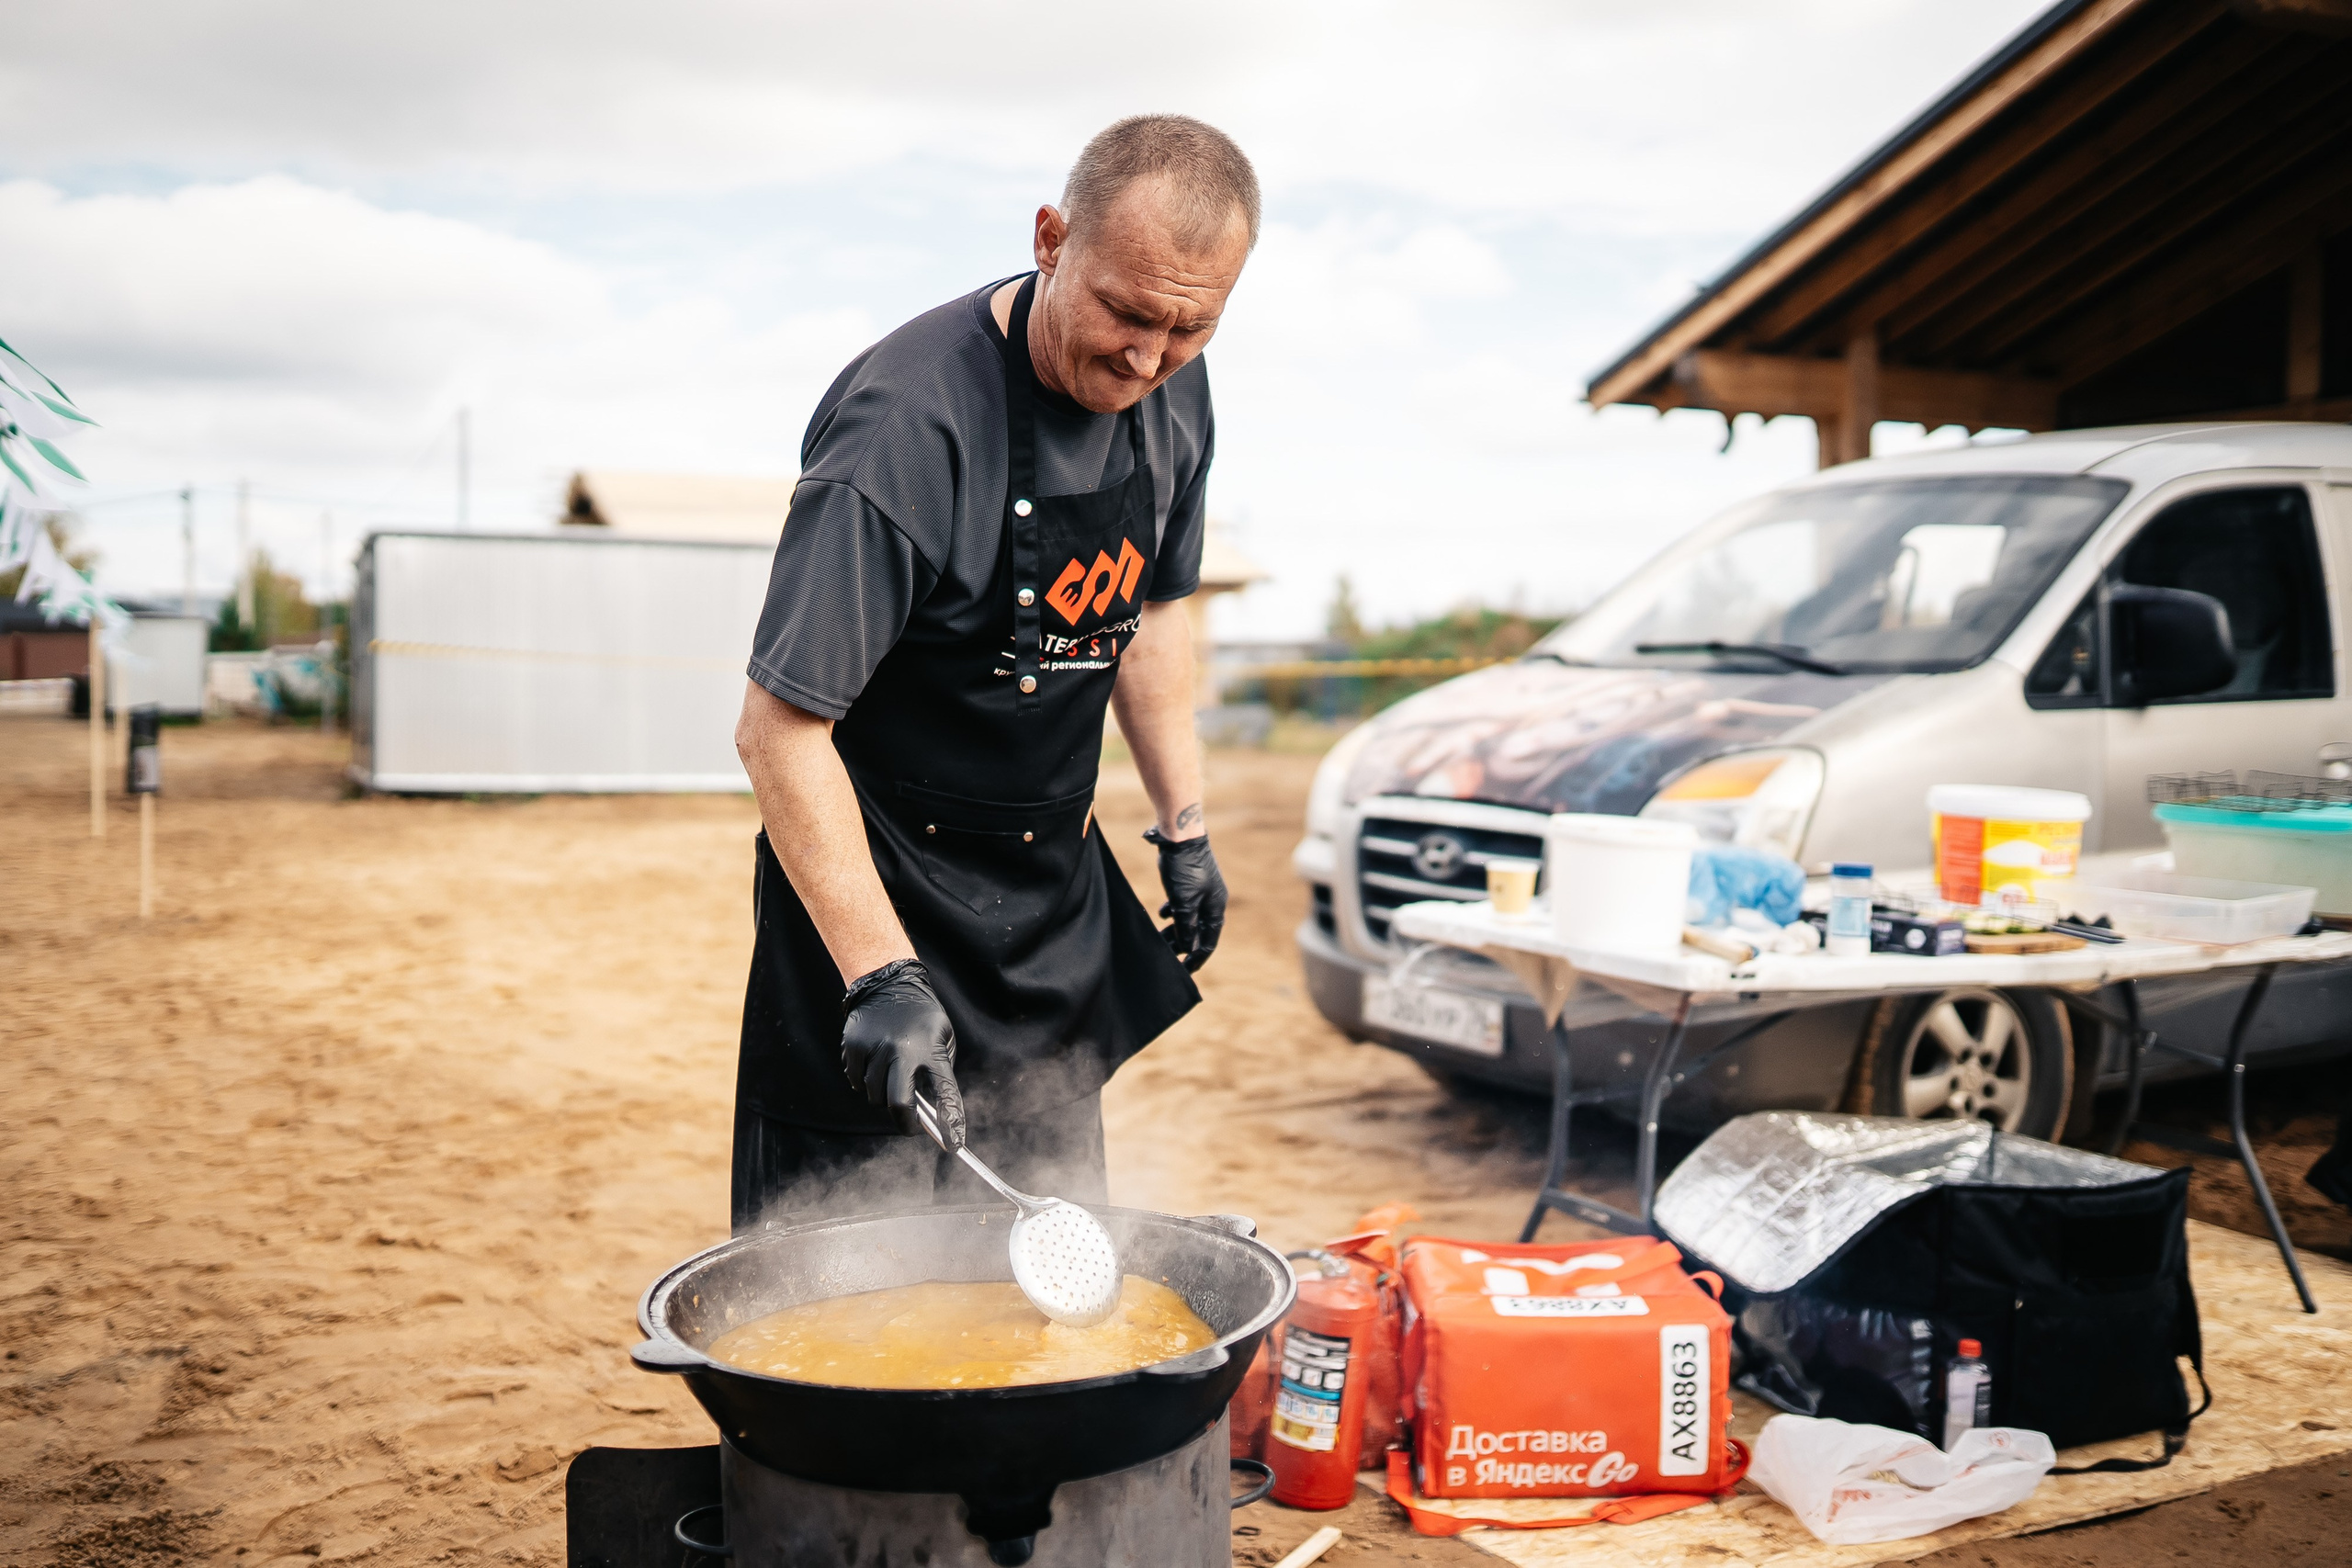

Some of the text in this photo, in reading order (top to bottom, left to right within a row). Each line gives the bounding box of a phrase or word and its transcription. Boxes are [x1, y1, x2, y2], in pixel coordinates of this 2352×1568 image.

[1671, 1341, 1698, 1461] AX8863
[1445, 1425, 1608, 1461] Доставка
[1446, 1466, 1467, 1486] в
